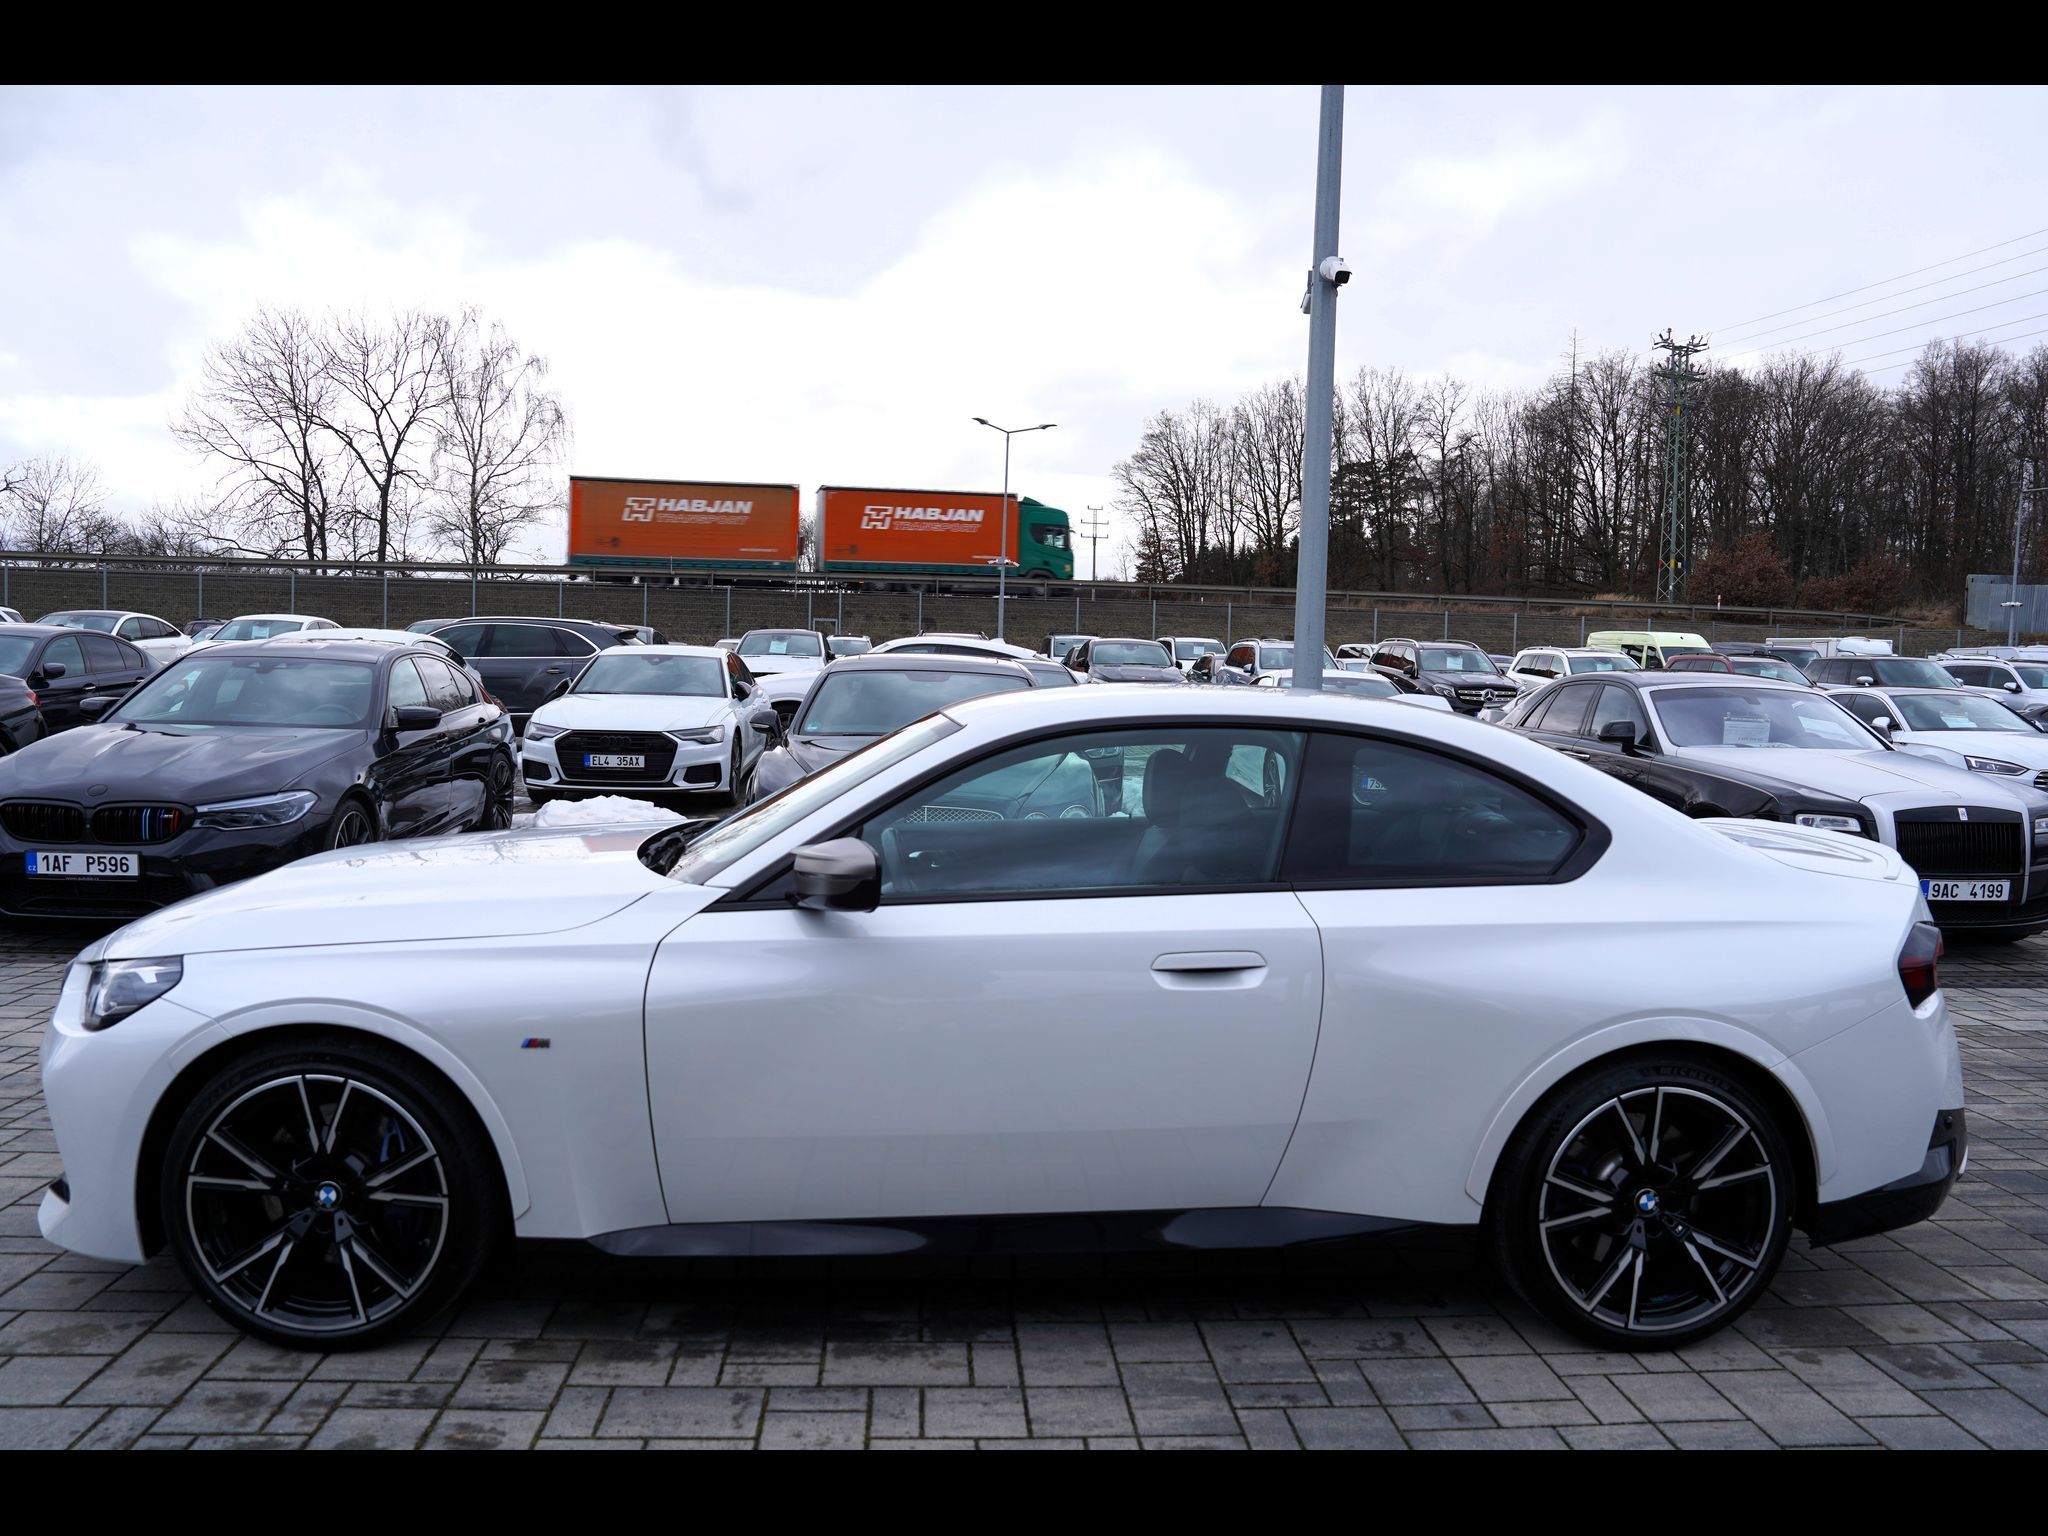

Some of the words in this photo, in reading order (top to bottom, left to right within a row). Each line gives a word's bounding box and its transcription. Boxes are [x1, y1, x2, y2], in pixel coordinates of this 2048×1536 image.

[657, 498, 753, 513] HABJAN
[893, 506, 985, 522] HABJAN
[591, 755, 610, 766] EL4
[616, 756, 640, 767] 35AX
[42, 854, 72, 872] 1AF
[86, 855, 130, 873] P596
[1931, 883, 1959, 899] 9AC
[1969, 883, 2004, 899] 4199
